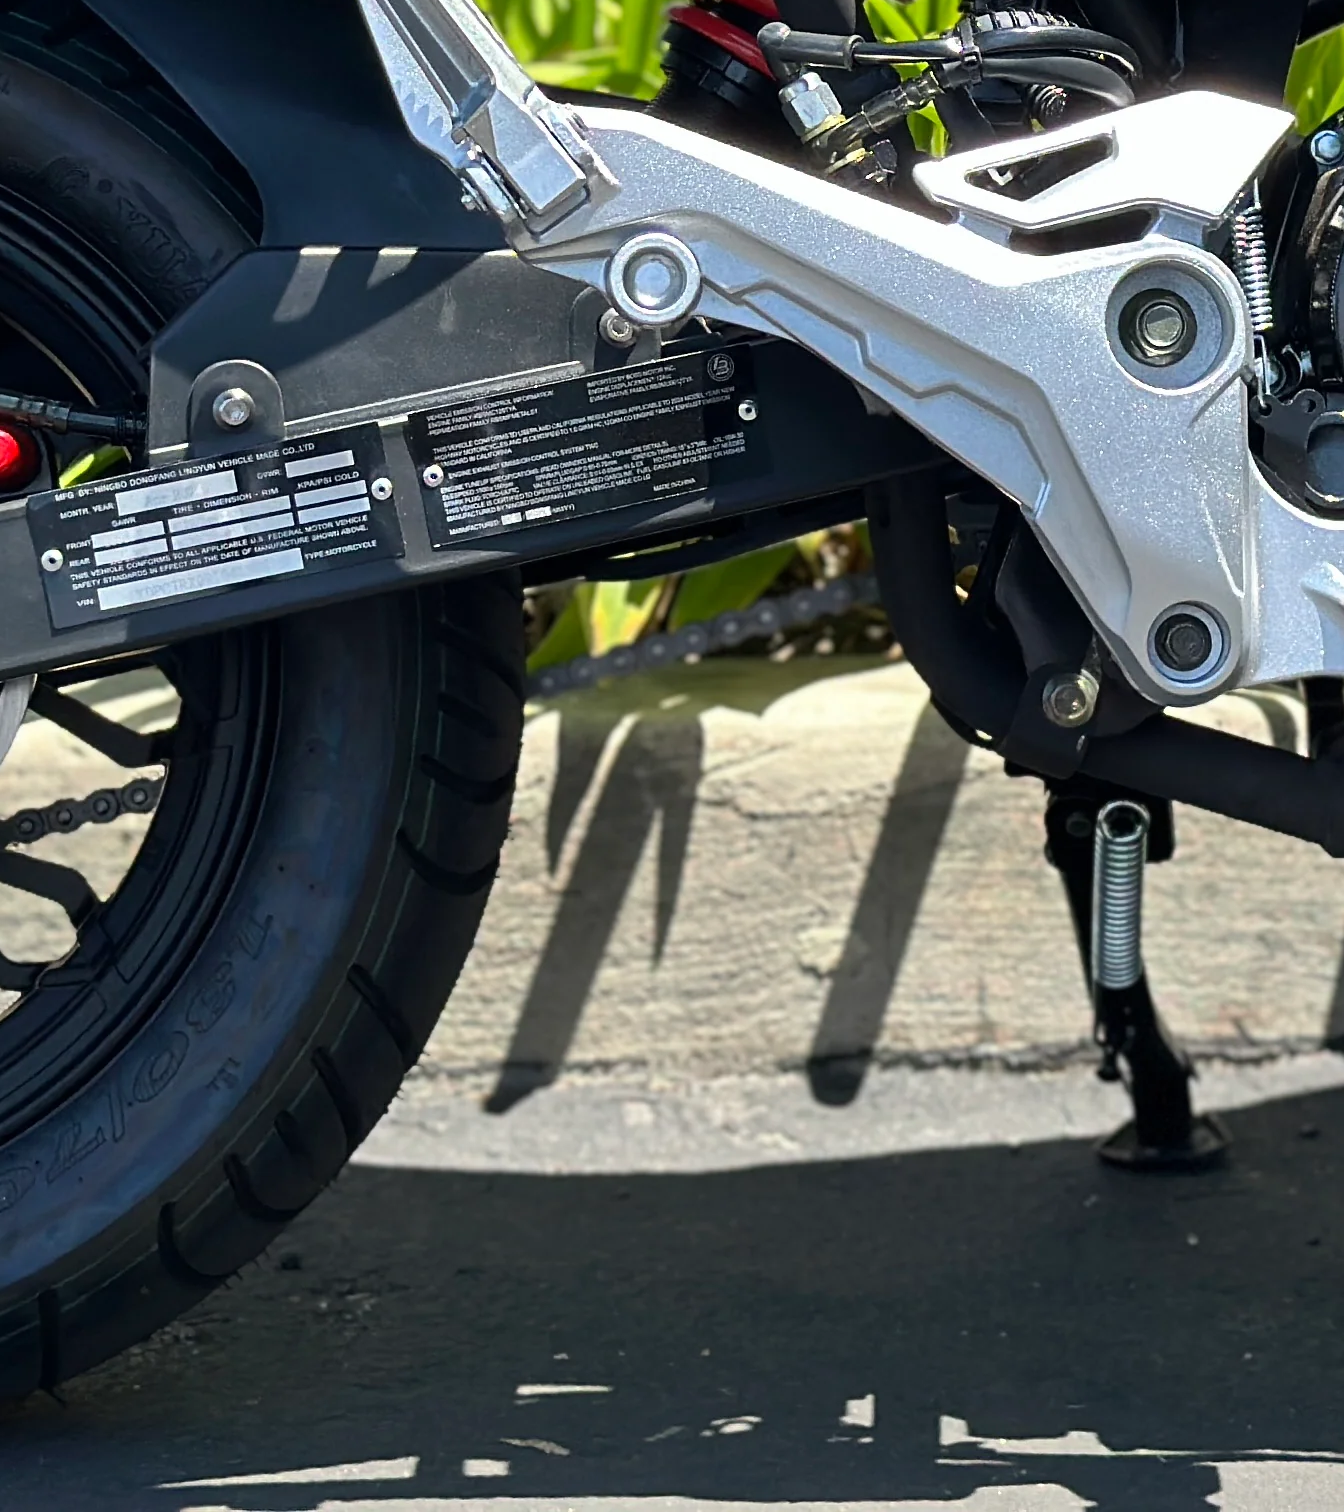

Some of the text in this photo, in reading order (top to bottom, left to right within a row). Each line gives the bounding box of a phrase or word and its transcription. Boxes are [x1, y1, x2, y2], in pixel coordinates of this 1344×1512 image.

[93, 480, 127, 493] NINGBO
[129, 470, 176, 486] DONGFANG
[218, 454, 254, 468] VEHICLE
[334, 470, 359, 482] COLD
[90, 564, 123, 577] VEHICLE
[125, 554, 170, 570] CONFORMS
